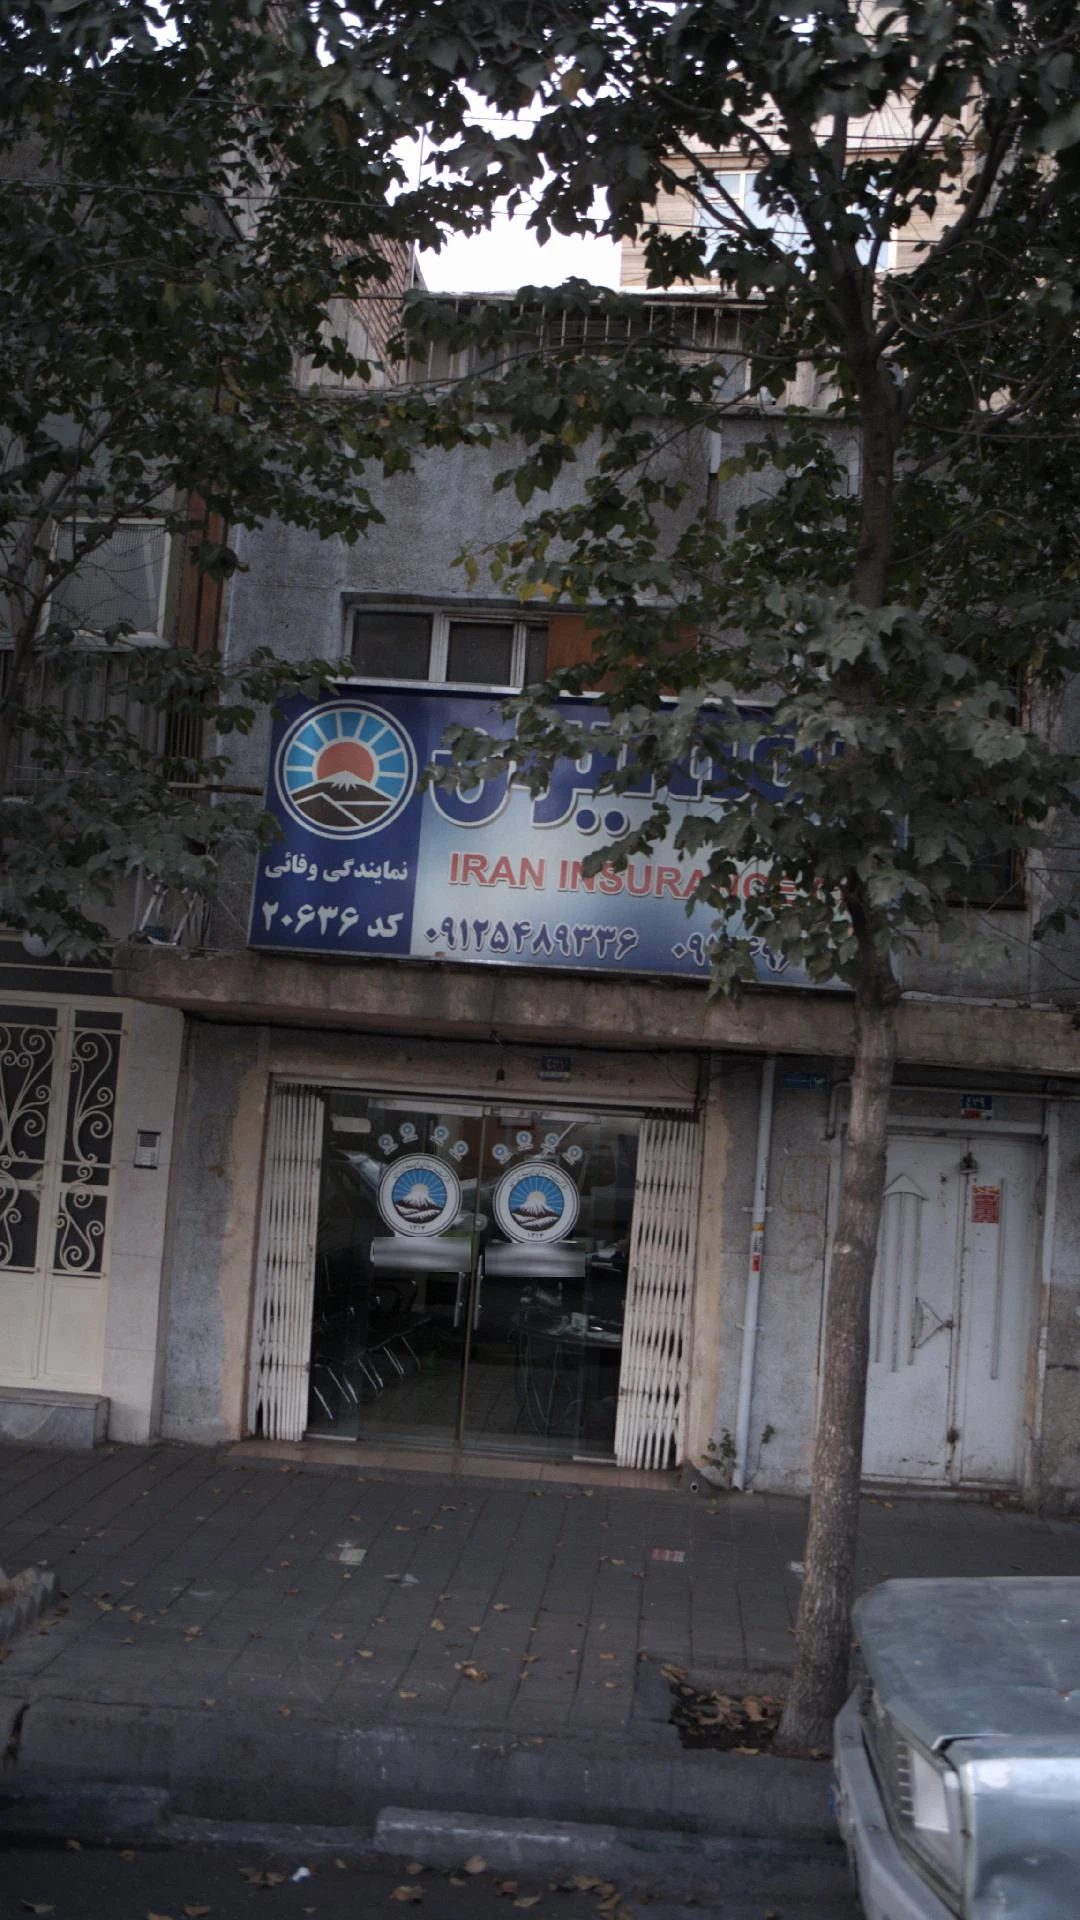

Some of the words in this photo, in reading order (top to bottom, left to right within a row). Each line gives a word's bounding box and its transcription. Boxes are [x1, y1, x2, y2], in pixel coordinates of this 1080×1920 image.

[322, 857, 408, 885] نمایندگی
[450, 852, 545, 889] IRAN
[261, 900, 360, 937] ۲۰۶۳۶
[367, 912, 405, 938] کد
[425, 916, 639, 960] ۰۹۱۲۵۴۸۹۳۳۶
